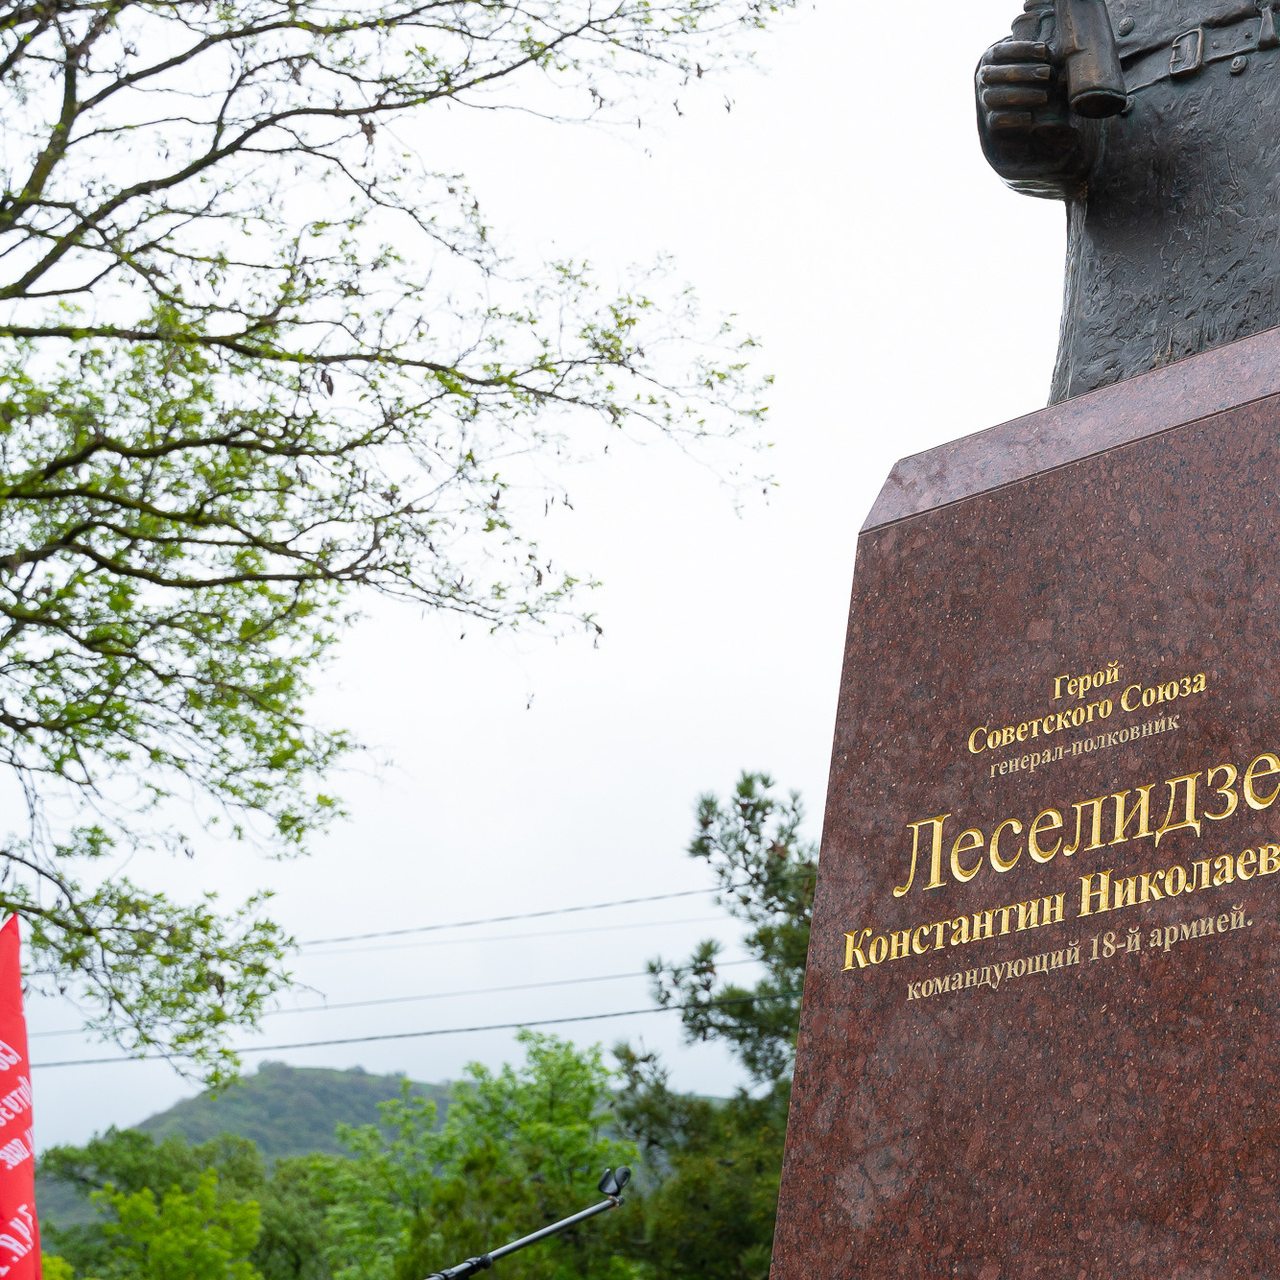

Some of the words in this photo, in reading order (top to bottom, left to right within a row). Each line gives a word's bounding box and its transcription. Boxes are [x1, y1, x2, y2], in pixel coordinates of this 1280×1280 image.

[968, 698, 1113, 754] Советского
[1121, 672, 1207, 712] Союза
[1053, 660, 1121, 700] Герой
[990, 714, 1181, 778] генерал-полковник
[841, 892, 1066, 971] Константин
[906, 939, 1082, 1001] командующий
[1089, 926, 1142, 961] 18-й
[1149, 903, 1253, 953] армией.
